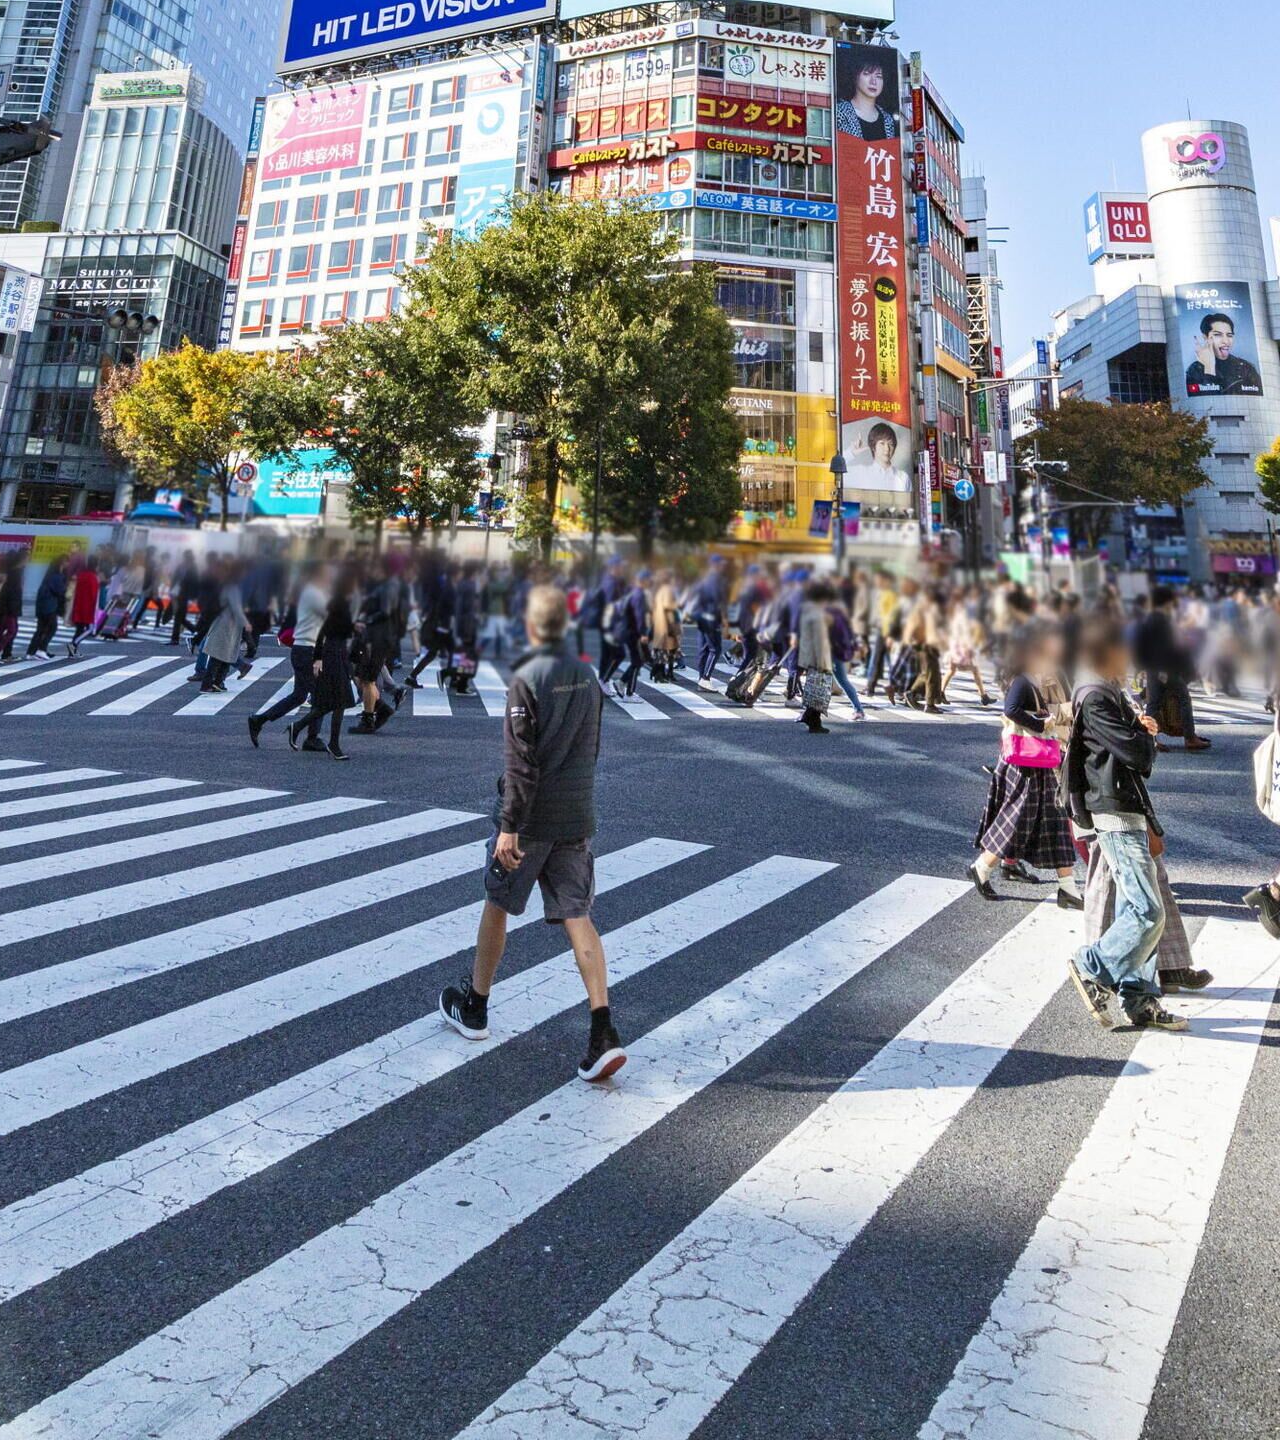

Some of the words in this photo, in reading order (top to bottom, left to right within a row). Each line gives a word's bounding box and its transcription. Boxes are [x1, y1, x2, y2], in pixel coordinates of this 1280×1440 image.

[314, 20, 356, 47] HIT
[362, 5, 416, 36] LED
[715, 23, 827, 49] しゃぶしゃぶバイキング
[761, 52, 827, 81] しゃぶ葉
[697, 96, 803, 128] コンタクト
[275, 141, 357, 172] 品川美容外科
[629, 136, 676, 161] ガスト
[771, 142, 822, 164] ガスト
[1163, 132, 1227, 174] 109
[701, 193, 735, 205] AEON
[740, 195, 835, 217] 英会話イーオン
[1111, 206, 1142, 222] UNI
[1113, 223, 1147, 240] QLO
[49, 278, 106, 291] MARK
[115, 277, 165, 290] CITY
[78, 267, 134, 277] SHIBUYA
[4, 275, 27, 329] 渋谷駅前
[849, 272, 872, 397] 「夢の振り子」
